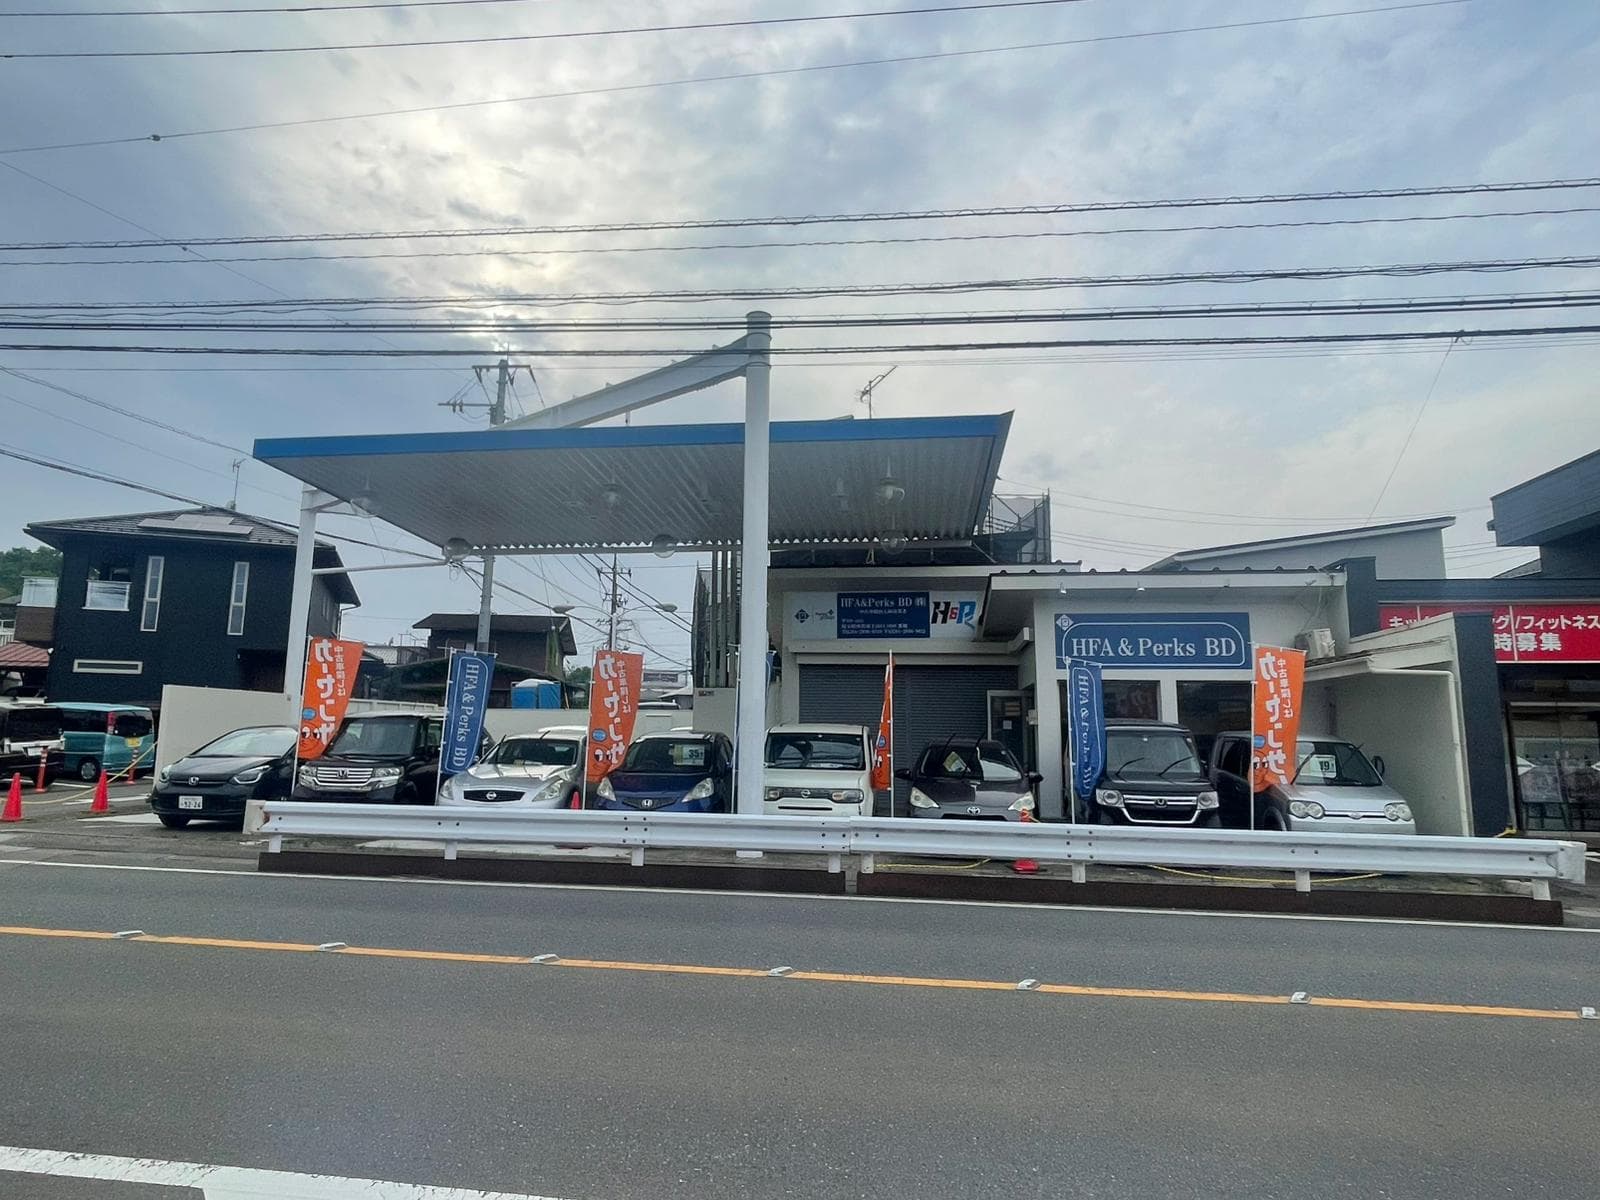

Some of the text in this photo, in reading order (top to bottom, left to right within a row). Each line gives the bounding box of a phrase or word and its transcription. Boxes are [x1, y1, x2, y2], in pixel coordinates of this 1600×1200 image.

[899, 597, 912, 607] BD
[1138, 637, 1196, 657] Perks
[1204, 637, 1236, 657] BD
[456, 706, 474, 742] Perks
[453, 747, 468, 767] BD
